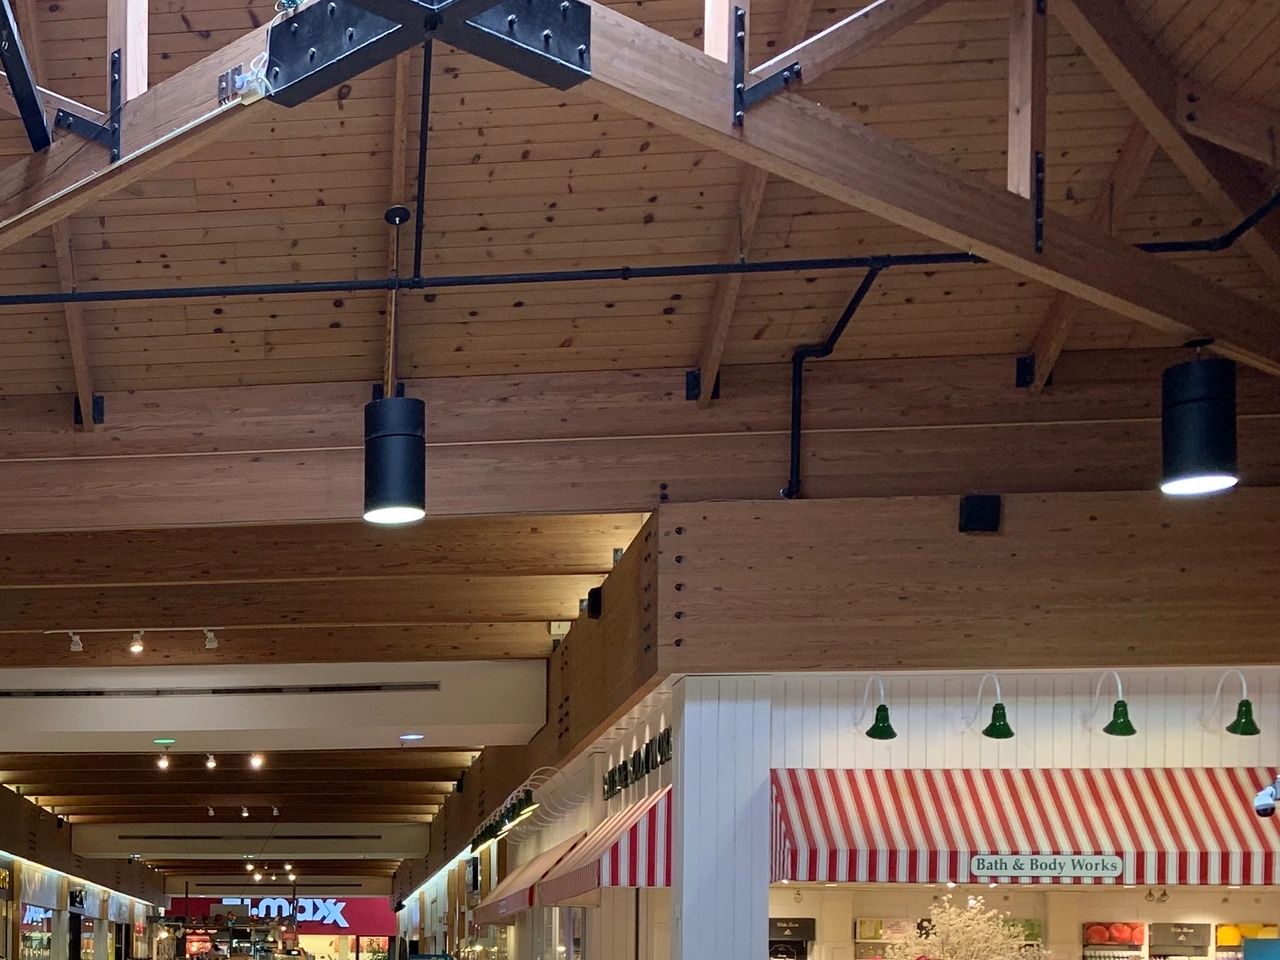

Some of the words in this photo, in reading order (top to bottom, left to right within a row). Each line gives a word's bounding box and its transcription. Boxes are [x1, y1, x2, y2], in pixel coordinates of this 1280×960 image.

[976, 857, 1008, 871] Bath
[1012, 858, 1025, 871] &
[1030, 858, 1066, 875] Body
[1071, 858, 1118, 872] Works
[222, 898, 349, 928] .maxx
